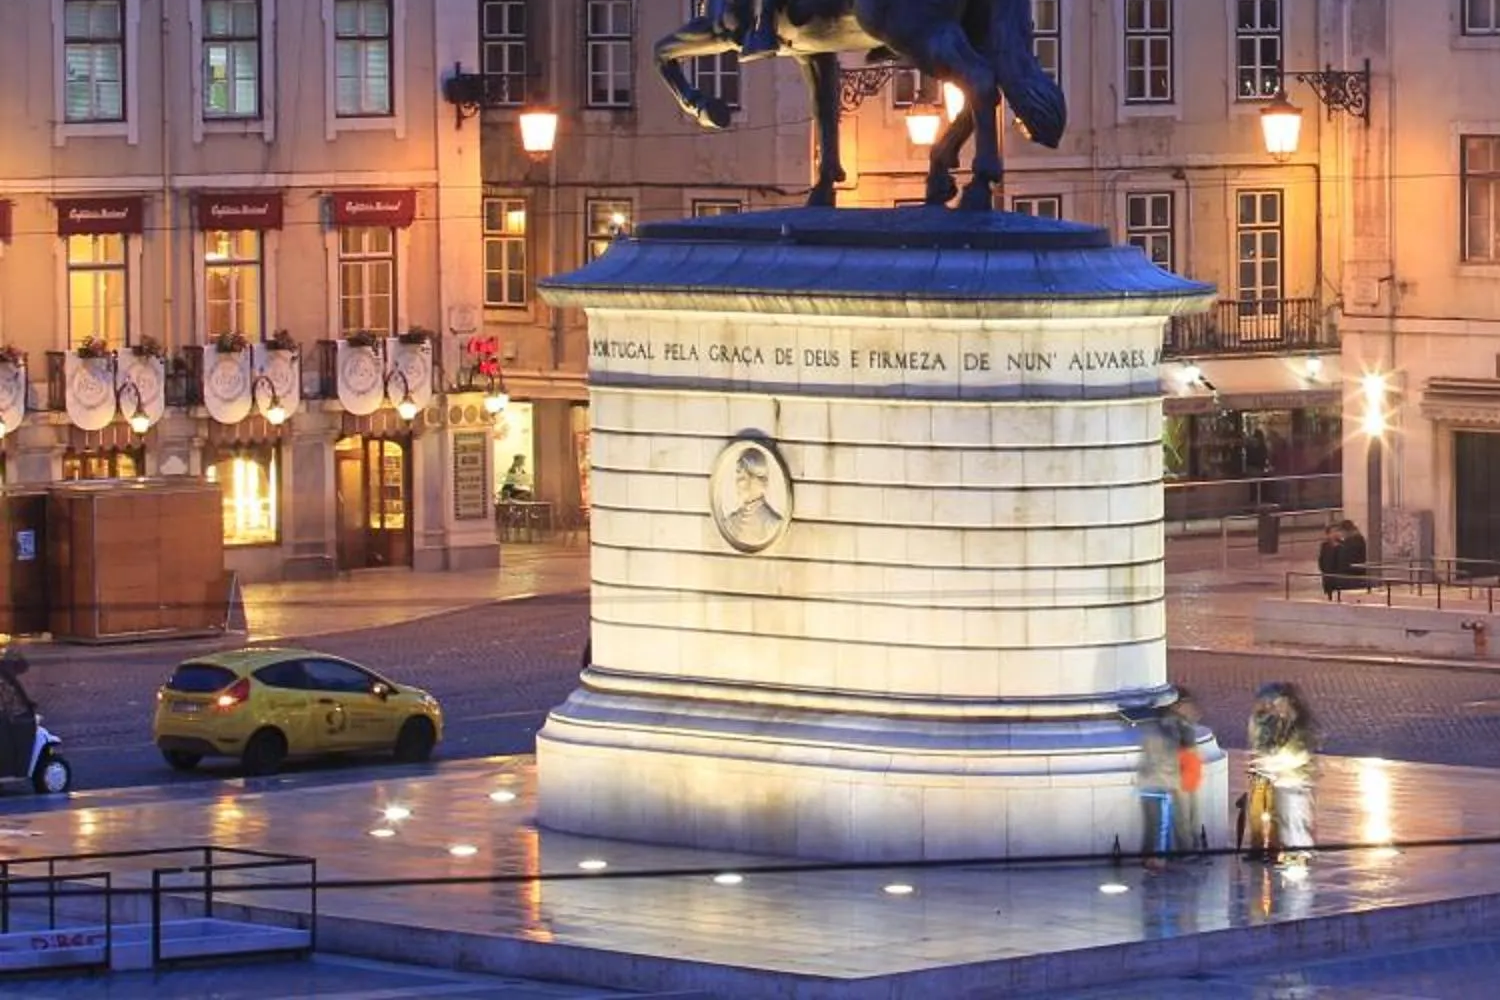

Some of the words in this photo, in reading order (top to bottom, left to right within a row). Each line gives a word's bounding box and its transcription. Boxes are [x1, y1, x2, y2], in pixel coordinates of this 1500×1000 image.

[664, 342, 699, 361] PELA
[709, 343, 764, 367] GRAÇA
[775, 347, 793, 366] DE
[804, 348, 840, 368] DEUS
[851, 350, 860, 369] E
[868, 350, 946, 371] FIRMEZA
[963, 352, 990, 371] DE
